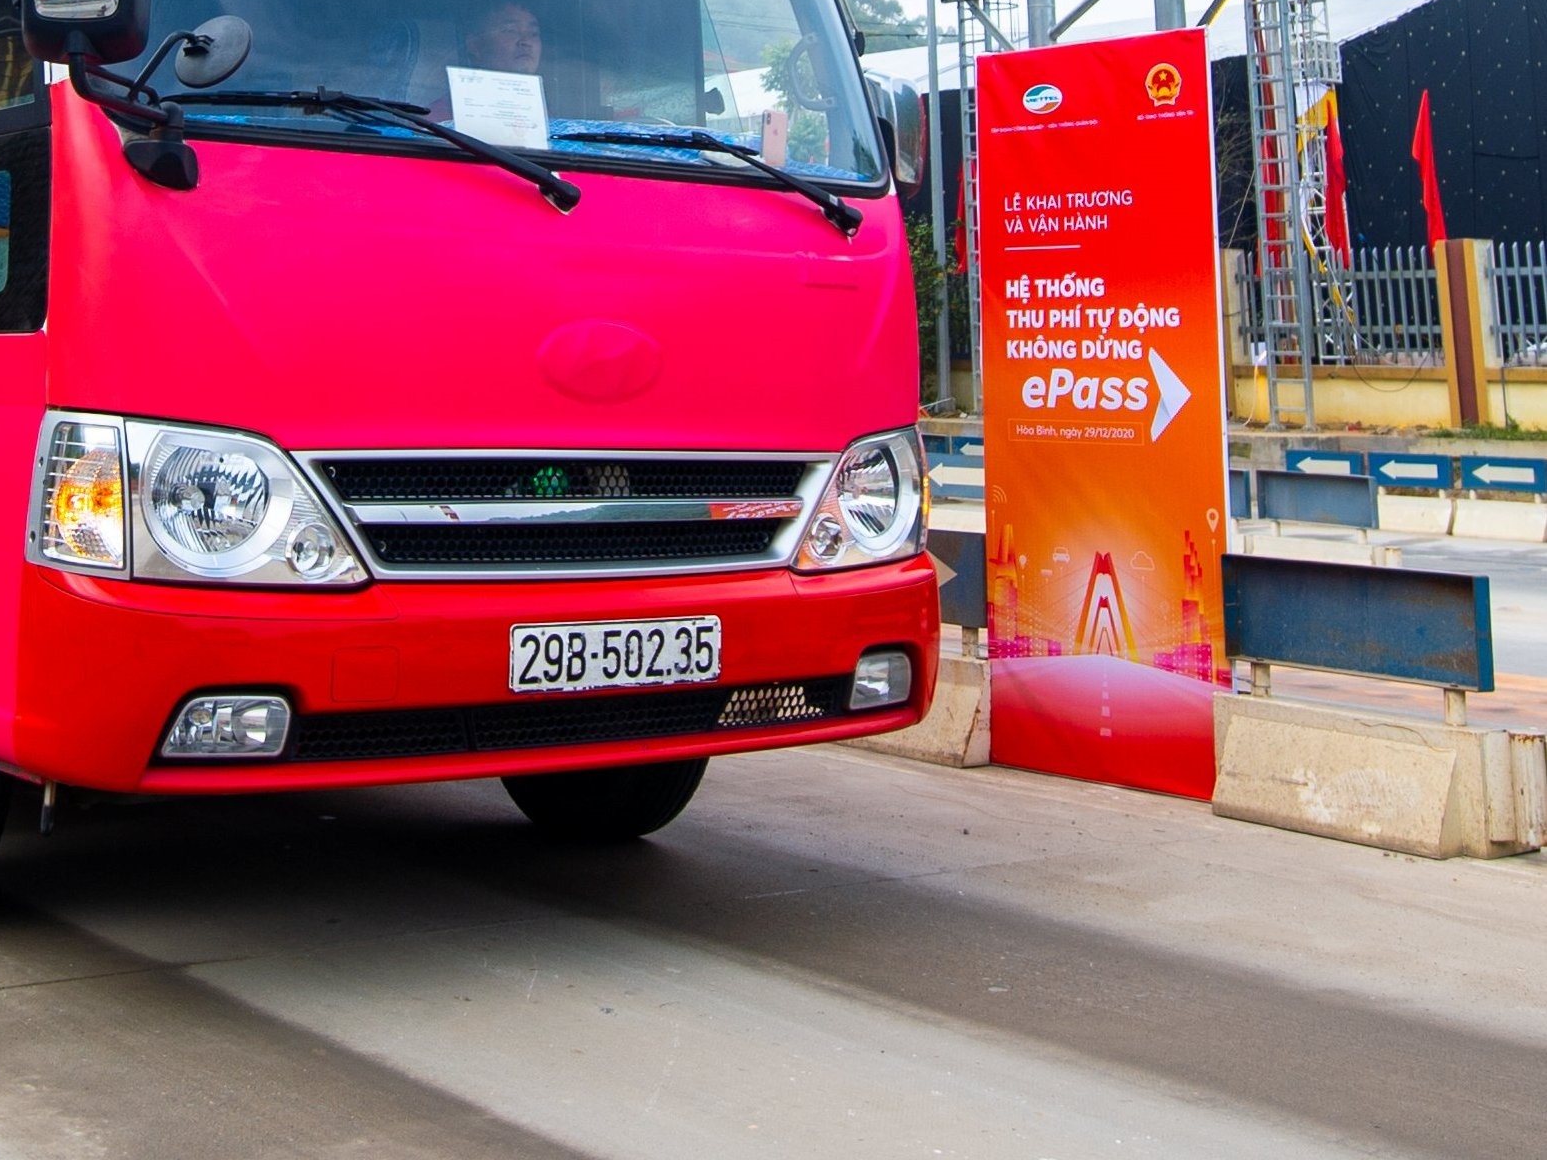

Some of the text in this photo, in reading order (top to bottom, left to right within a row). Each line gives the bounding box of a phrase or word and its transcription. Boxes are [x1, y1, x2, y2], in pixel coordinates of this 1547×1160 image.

[1005, 190, 1133, 212] LỄ KHAI TRƯƠNG
[1005, 212, 1108, 236] VÀ VẬN HÀNH
[1006, 272, 1105, 304] HỆ THỐNG
[1006, 303, 1181, 334] THU PHÍ TỰ ĐỘNG
[1006, 335, 1143, 359] KHÔNG DỪNG
[1021, 368, 1149, 411] ePass
[1016, 425, 1034, 435] Hòa
[1060, 427, 1082, 439] ngày
[1084, 427, 1135, 439] 29/12/2020
[519, 625, 715, 685] 29B-502.35
